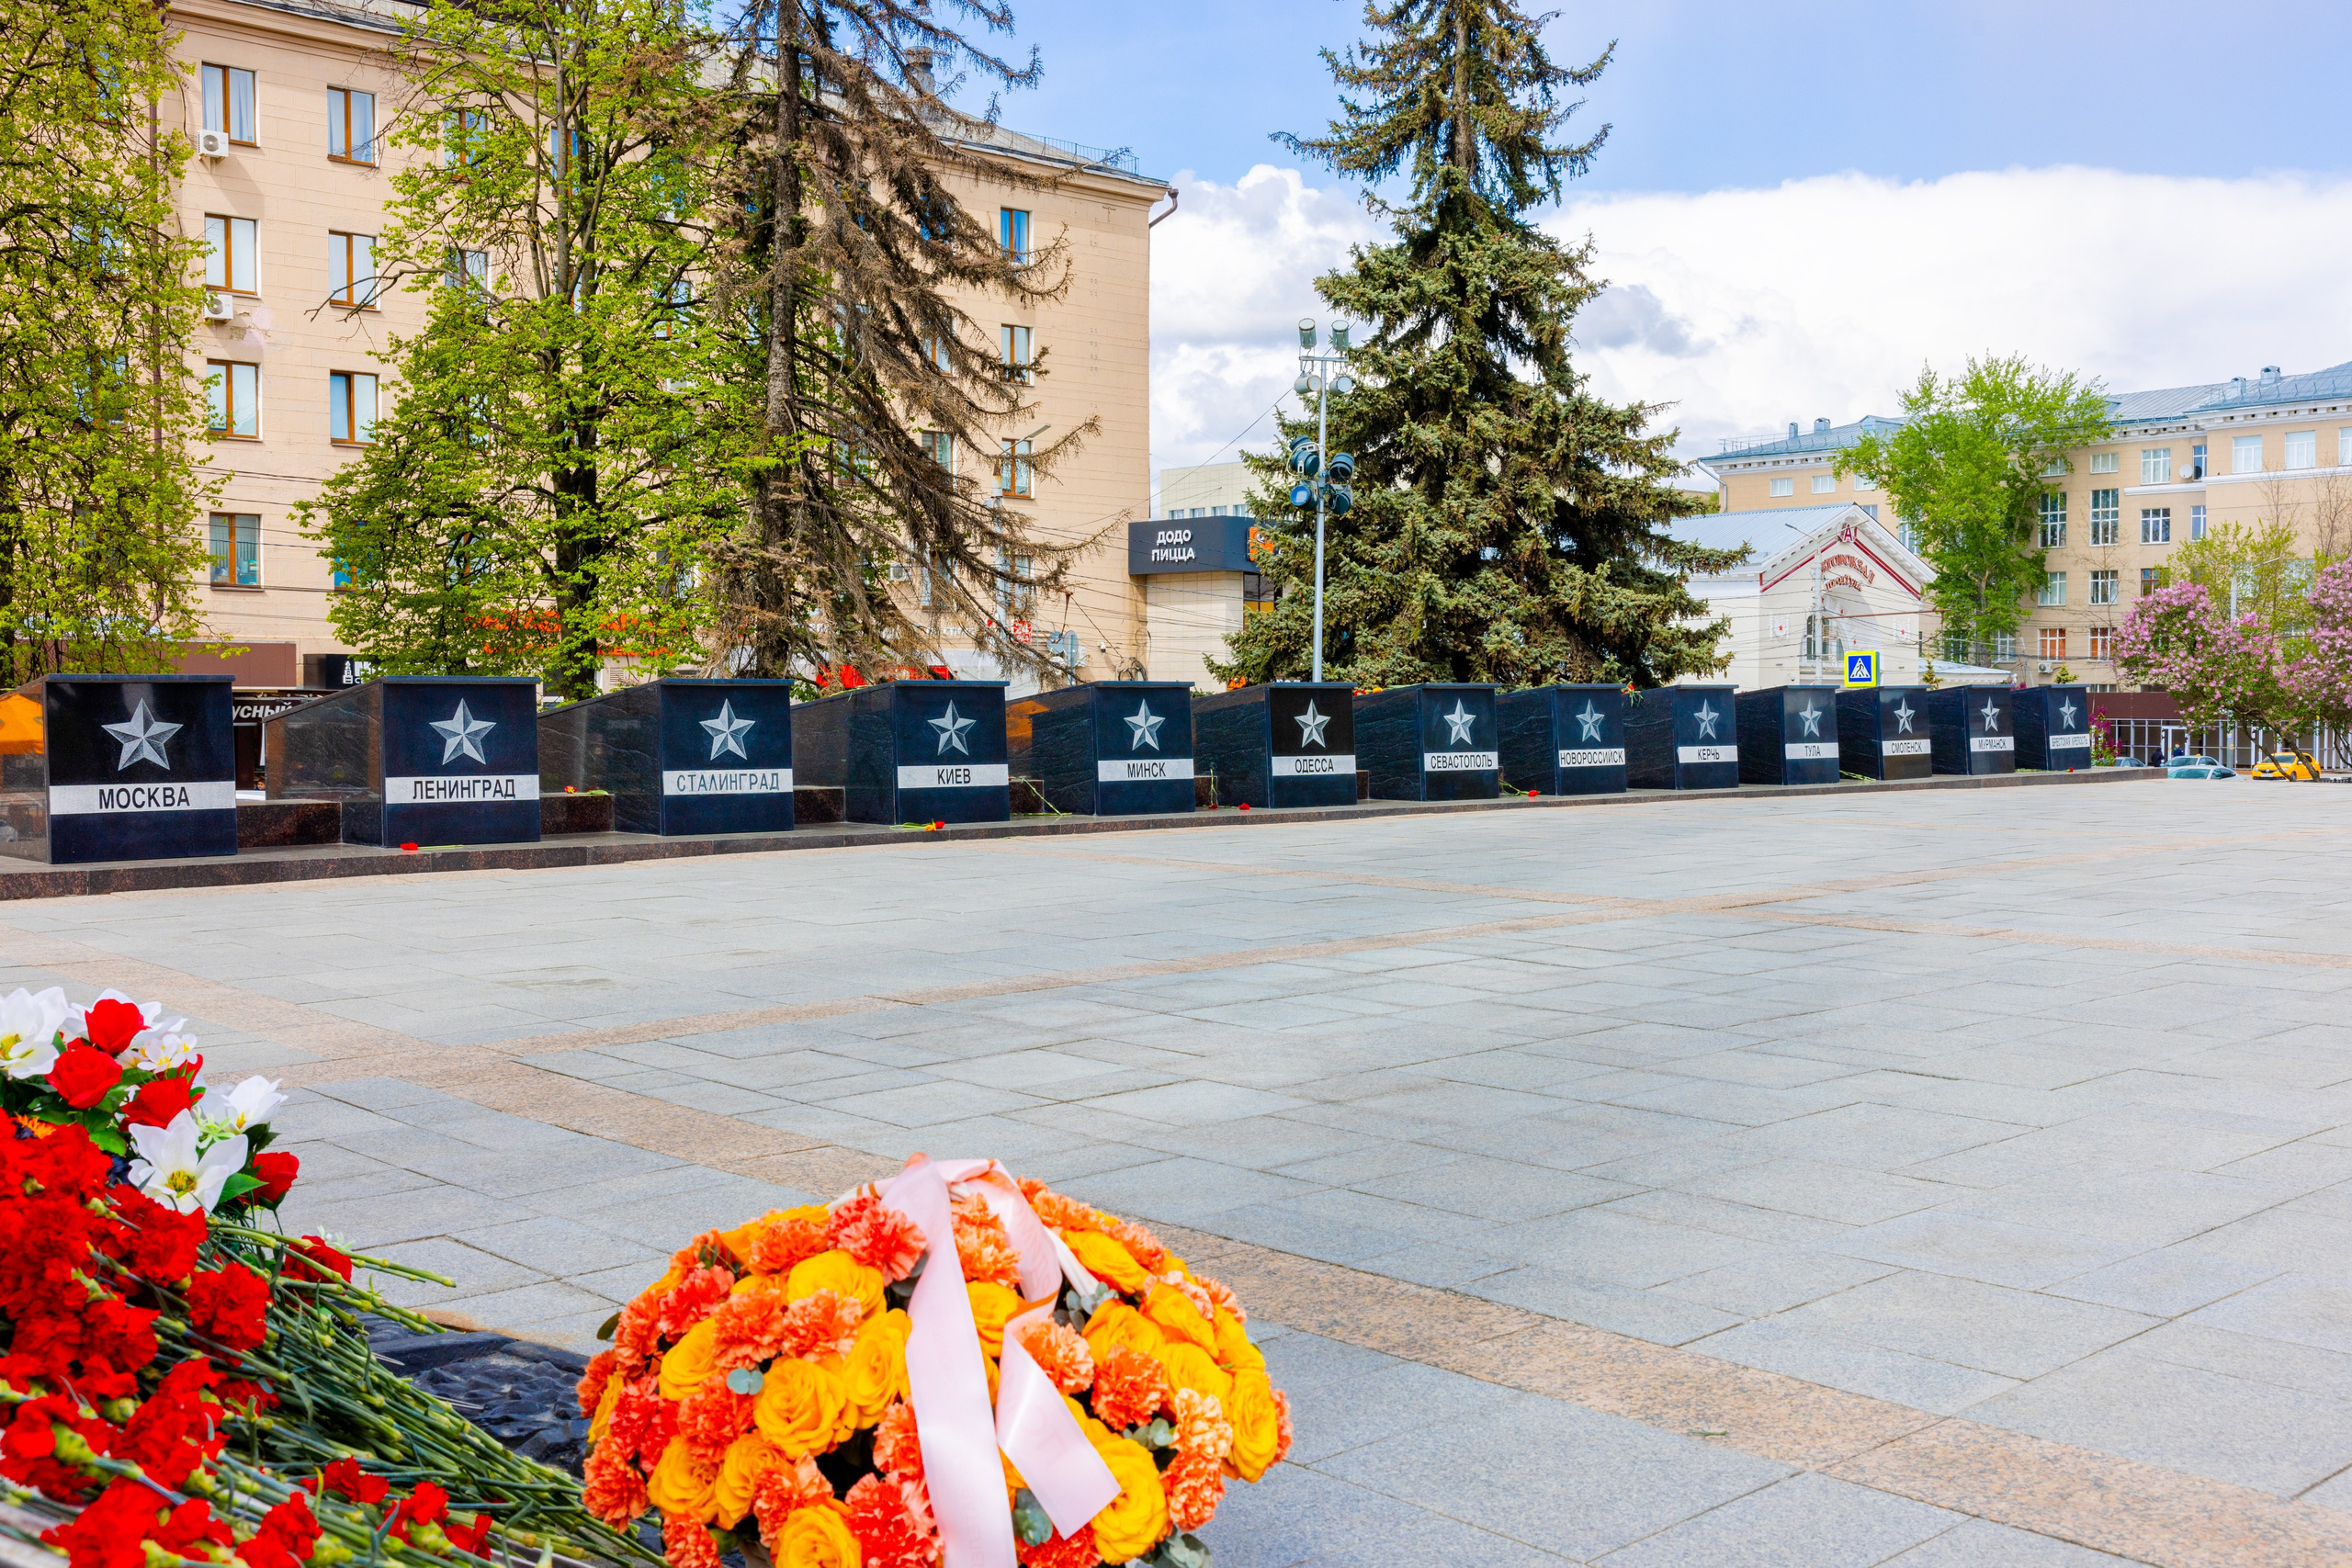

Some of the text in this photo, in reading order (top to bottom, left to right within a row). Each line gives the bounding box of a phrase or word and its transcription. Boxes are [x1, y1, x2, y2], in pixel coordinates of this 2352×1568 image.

[1157, 529, 1192, 546] ДОДО
[1151, 547, 1195, 562] ПИЦЦА
[1804, 745, 1822, 757] ТУЛА
[1891, 741, 1923, 753] СМОЛЕНСК
[1978, 739, 2007, 750] МУРМАНСК
[1430, 754, 1493, 769] СЕВАСТОПОЛЬ
[1560, 750, 1623, 764] НОВОРОССИЙСК
[1697, 748, 1720, 761] КЕРЧЬ
[1127, 762, 1166, 778] МИНСК
[1295, 758, 1334, 773] ОДЕССА
[676, 773, 780, 792] СТАЛИНГРАД
[937, 768, 971, 784] КИЕВ
[413, 779, 516, 799] ЛЕНИНГРАД
[98, 786, 190, 809] МОСКВА
